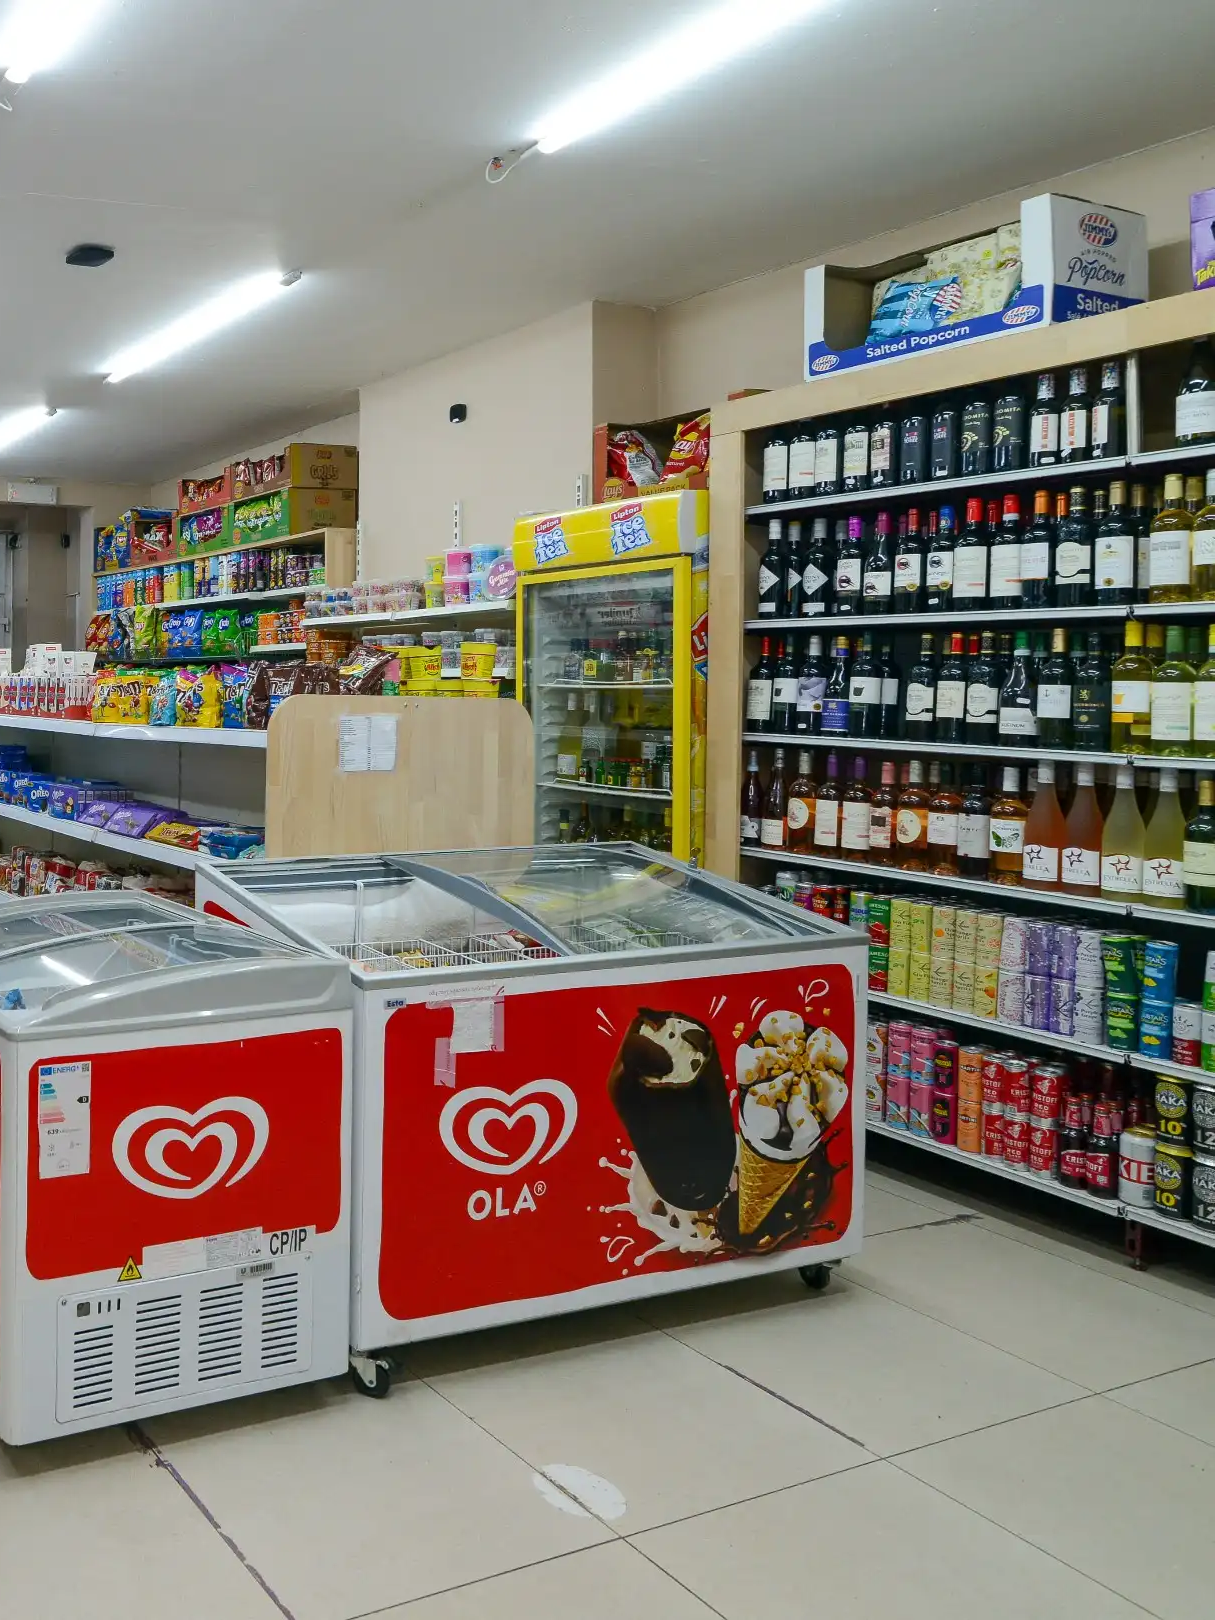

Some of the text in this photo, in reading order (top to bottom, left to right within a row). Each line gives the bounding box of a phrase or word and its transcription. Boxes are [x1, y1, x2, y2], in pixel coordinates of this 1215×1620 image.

[1077, 293, 1119, 311] Salted
[866, 325, 970, 358] Salted Popcorn
[613, 504, 641, 521] Lipton
[536, 518, 560, 533] Lipton
[611, 516, 645, 538] Ice
[535, 528, 564, 547] Ice
[611, 531, 651, 555] Tea
[535, 543, 569, 565] Tea
[30, 789, 50, 800] OREO
[386, 1000, 404, 1008] Esta
[269, 1228, 307, 1256] CP/IP
